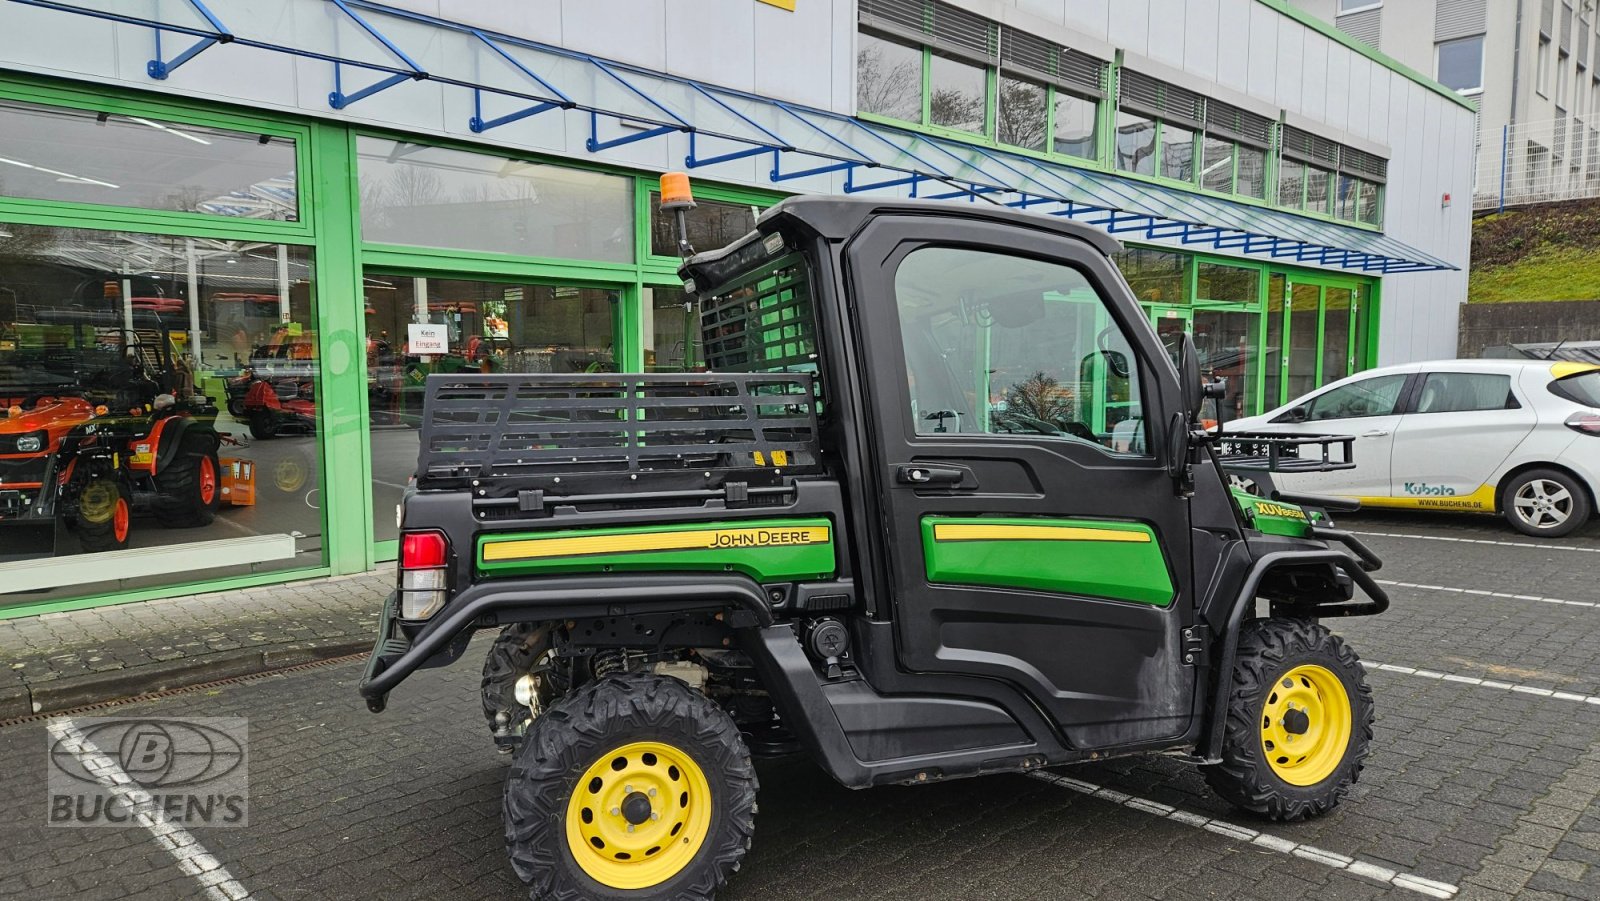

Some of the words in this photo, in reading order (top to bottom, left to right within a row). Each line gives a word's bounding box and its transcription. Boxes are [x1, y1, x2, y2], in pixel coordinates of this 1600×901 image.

[415, 340, 441, 349] Eingang
[1404, 482, 1456, 496] Kubota
[709, 532, 754, 547] JOHN
[758, 531, 811, 544] DEERE
